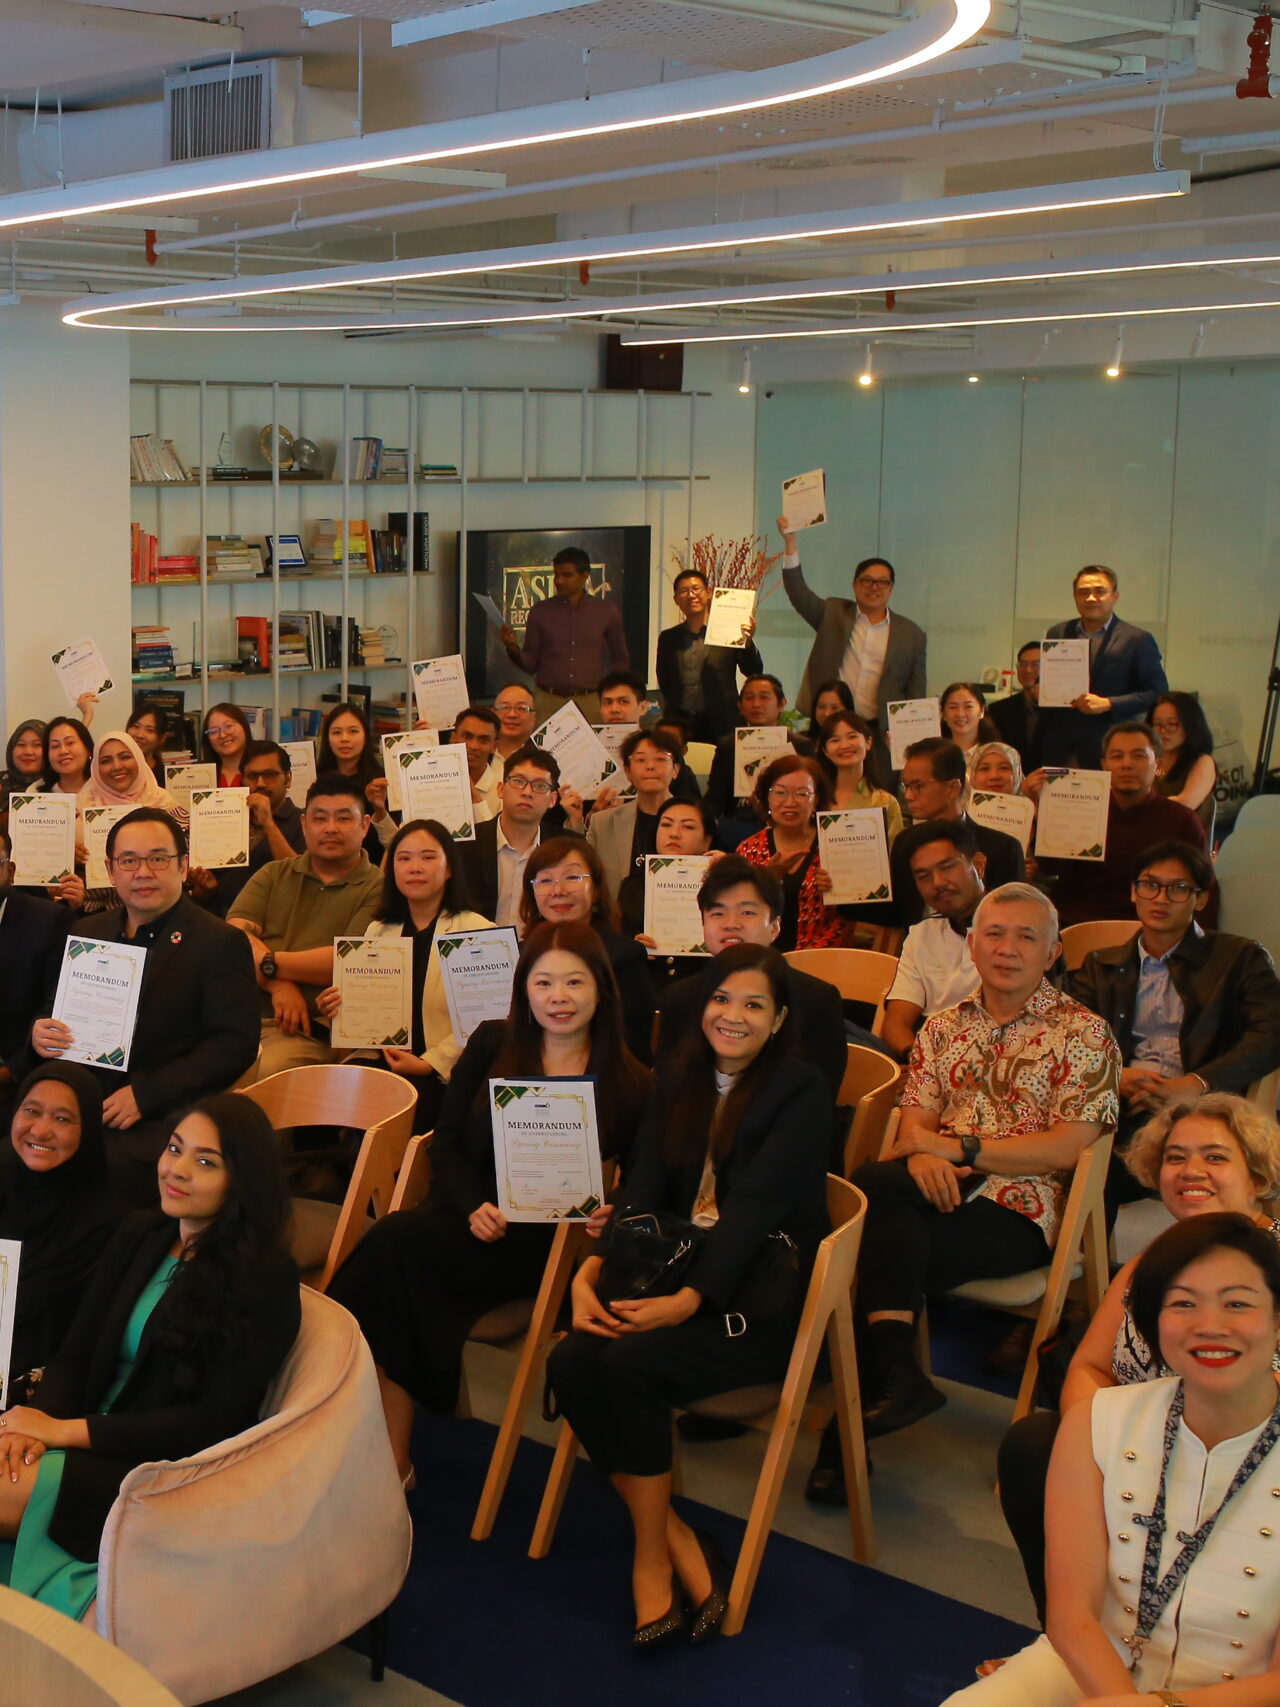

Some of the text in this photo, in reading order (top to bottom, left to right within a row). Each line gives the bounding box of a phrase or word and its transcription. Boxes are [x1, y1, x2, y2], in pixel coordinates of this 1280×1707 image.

[410, 772, 460, 782] MEMORANDUM
[452, 962, 510, 974] MEMORANDUM
[72, 971, 129, 988] MEMORANDUM
[508, 1121, 582, 1130] MEMORANDUM
